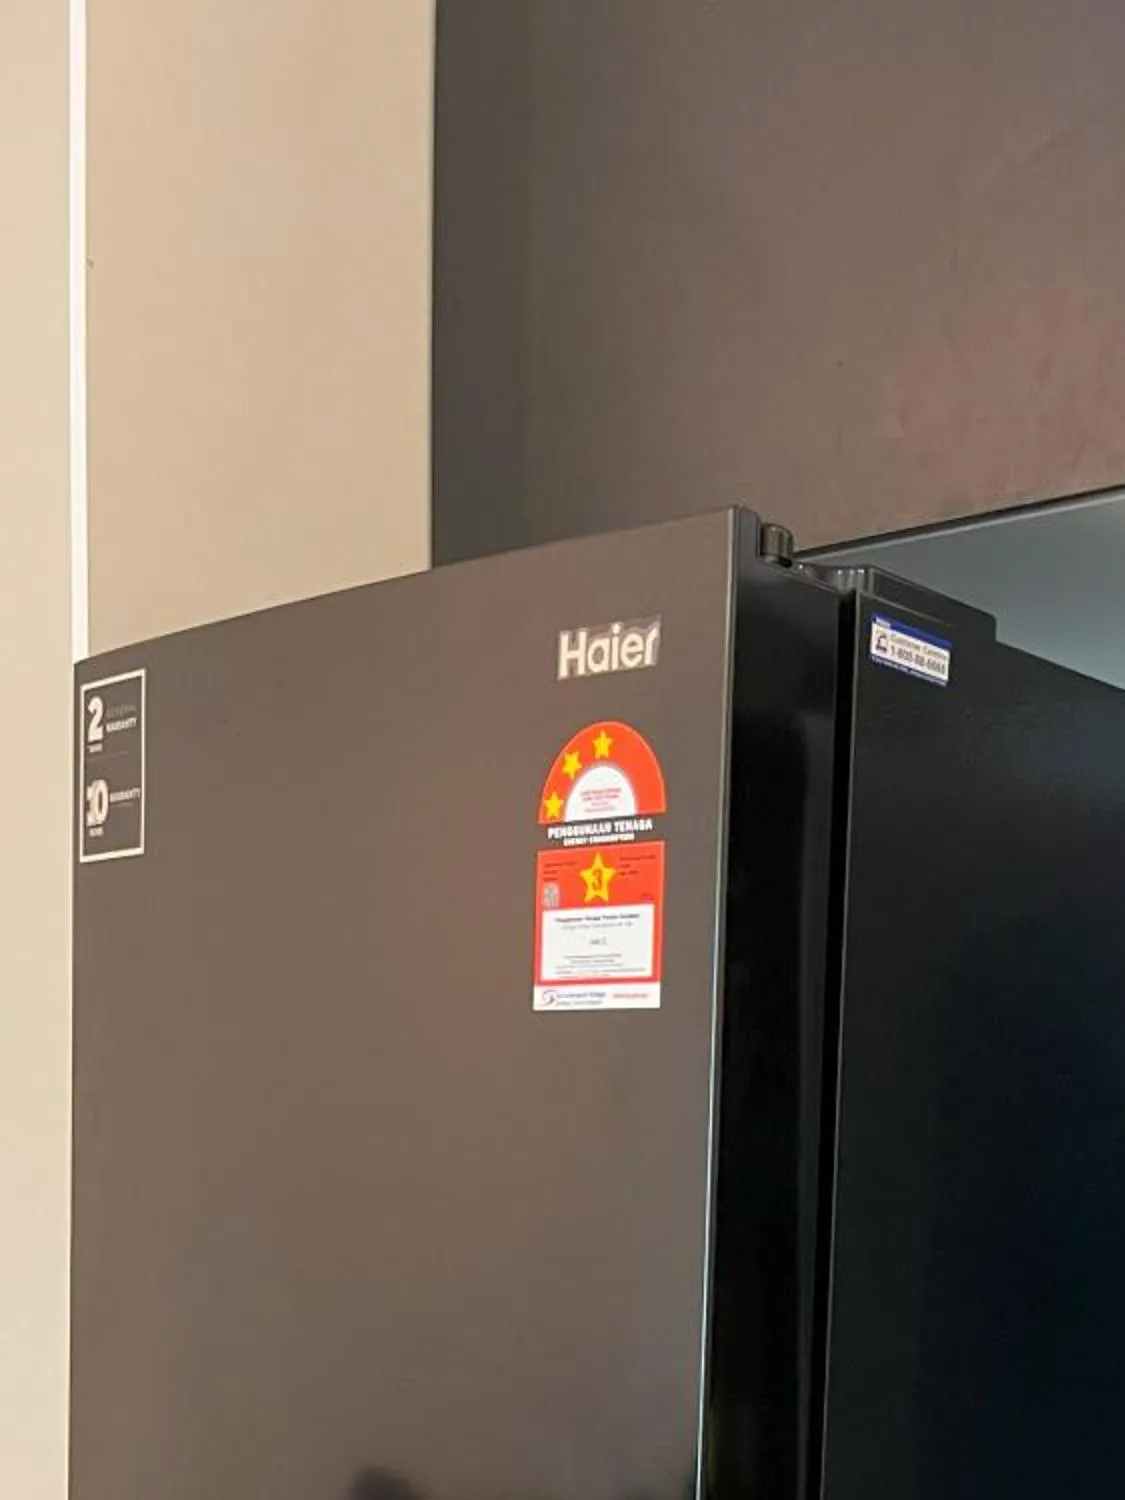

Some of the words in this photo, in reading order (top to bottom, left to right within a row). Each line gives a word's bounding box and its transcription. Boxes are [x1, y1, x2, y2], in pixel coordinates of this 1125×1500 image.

[557, 619, 660, 680] Haier
[87, 695, 103, 743] 2
[613, 818, 653, 833] TENAGA
[591, 868, 602, 891] 3
